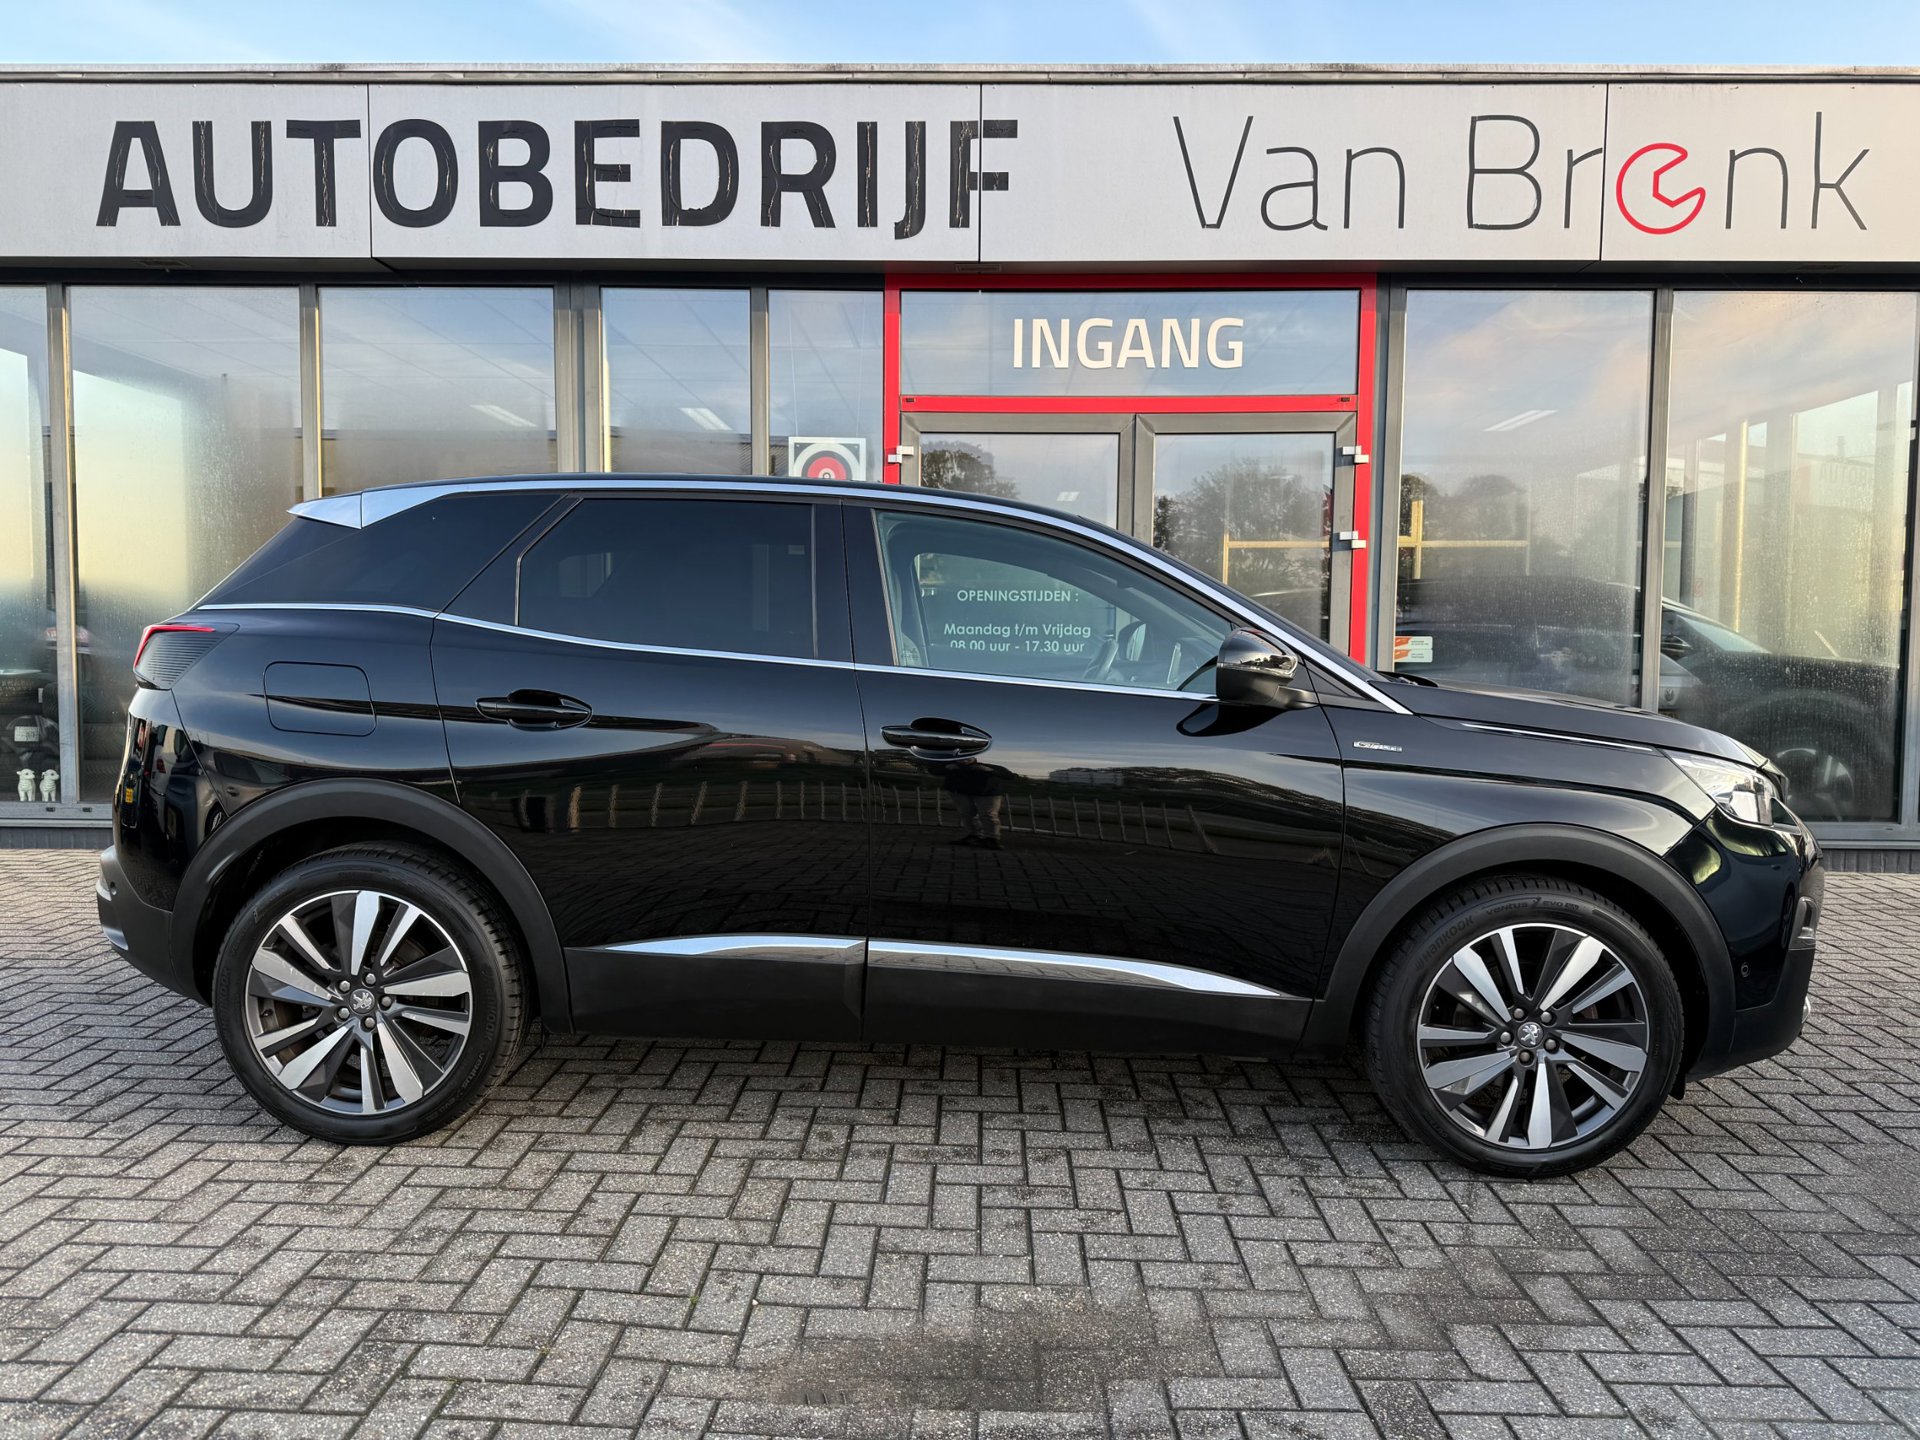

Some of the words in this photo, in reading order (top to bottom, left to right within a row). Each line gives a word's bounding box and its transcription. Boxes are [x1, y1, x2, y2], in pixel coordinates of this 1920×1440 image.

[97, 118, 1018, 240] AUTOBEDRIJF
[1173, 115, 1406, 231] Van
[1013, 317, 1244, 369] INGANG
[956, 589, 1071, 602] OPENINGSTIJDEN
[943, 623, 1011, 638] Maandag
[1014, 623, 1039, 637] t/m
[1042, 623, 1092, 639] Vrijdag
[989, 642, 1011, 652] uur
[1025, 640, 1060, 652] 17.30
[1063, 642, 1085, 652] uur
